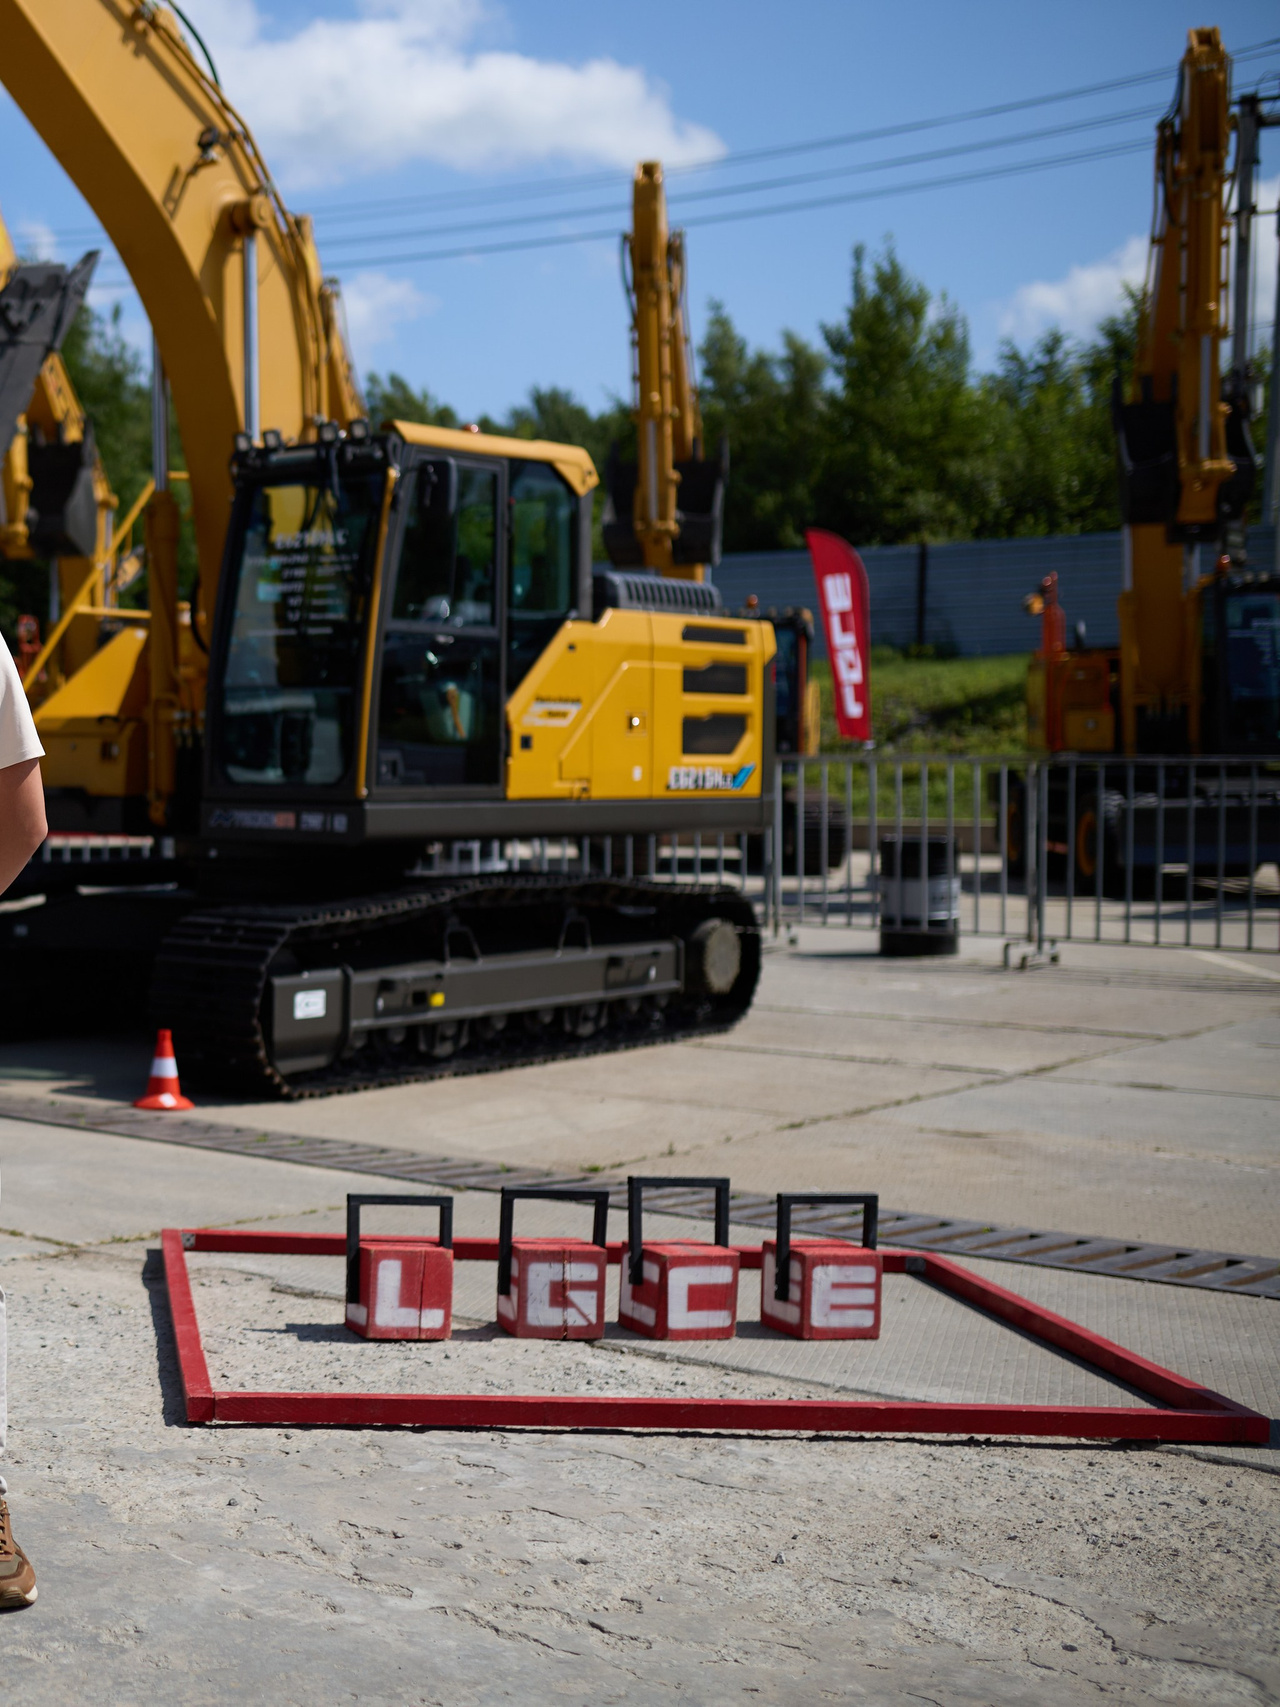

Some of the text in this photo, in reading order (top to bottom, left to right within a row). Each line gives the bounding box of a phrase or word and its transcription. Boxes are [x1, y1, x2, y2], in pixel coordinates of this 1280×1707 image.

[375, 1260, 445, 1329] L
[527, 1262, 598, 1327] G
[668, 1266, 733, 1330] C
[811, 1265, 876, 1328] E
